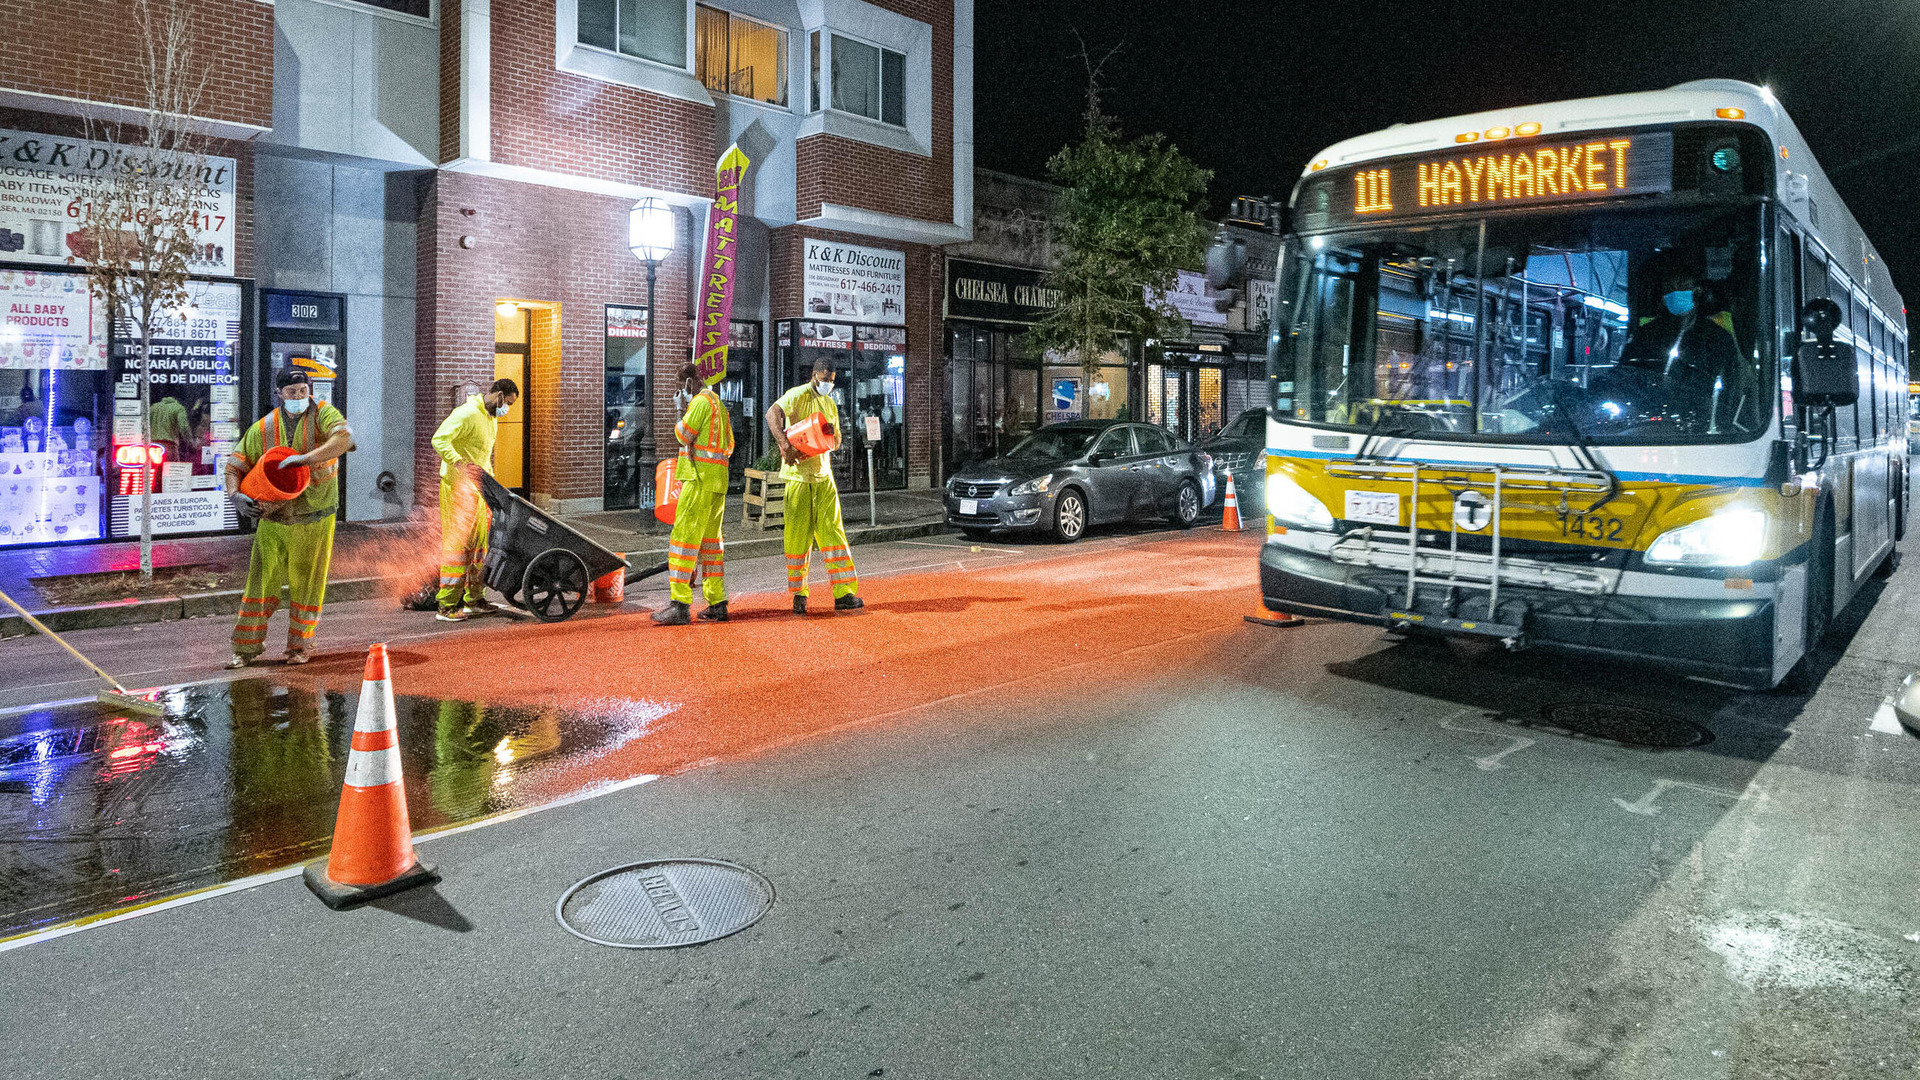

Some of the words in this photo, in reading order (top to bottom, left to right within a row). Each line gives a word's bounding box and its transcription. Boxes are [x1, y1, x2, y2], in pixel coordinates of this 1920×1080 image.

[47, 142, 76, 167] K
[1354, 168, 1393, 213] 111
[1418, 139, 1631, 207] HAYMARKET
[28, 182, 70, 196] ITEMS
[808, 244, 820, 260] K
[820, 246, 832, 262] &
[832, 248, 844, 264] K
[846, 250, 903, 271] Discount
[702, 195, 738, 346] MATTRESS
[808, 263, 851, 276] MATTRESSES
[850, 268, 866, 277] AND
[866, 270, 902, 281] FURNITURE
[840, 278, 902, 296] 617-466-2417
[955, 277, 1009, 304] CHELSEA
[10, 303, 32, 314] ALL
[34, 304, 65, 315] BABY
[292, 304, 318, 318] 302
[6, 315, 69, 327] PRODUCTS
[190, 318, 218, 329] 3236
[166, 328, 187, 338] 461
[190, 329, 218, 339] 8671
[608, 327, 648, 338] DINING
[736, 340, 754, 349] SET
[804, 340, 847, 350] MATTRESS
[863, 342, 897, 351] BEDDING
[184, 346, 232, 357] AEREOS
[125, 356, 178, 369] NOARÍA
[180, 358, 231, 370] PÚBLICA
[122, 373, 168, 383] ENOS
[170, 374, 188, 384] DE
[189, 375, 233, 384] DINERO
[180, 496, 210, 505] EUROPA,
[213, 501, 219, 509] A
[173, 511, 188, 519] LAS
[188, 509, 212, 518] VEGAS
[213, 507, 219, 516] Y
[1460, 499, 1485, 524] T
[1558, 511, 1623, 542] 1432
